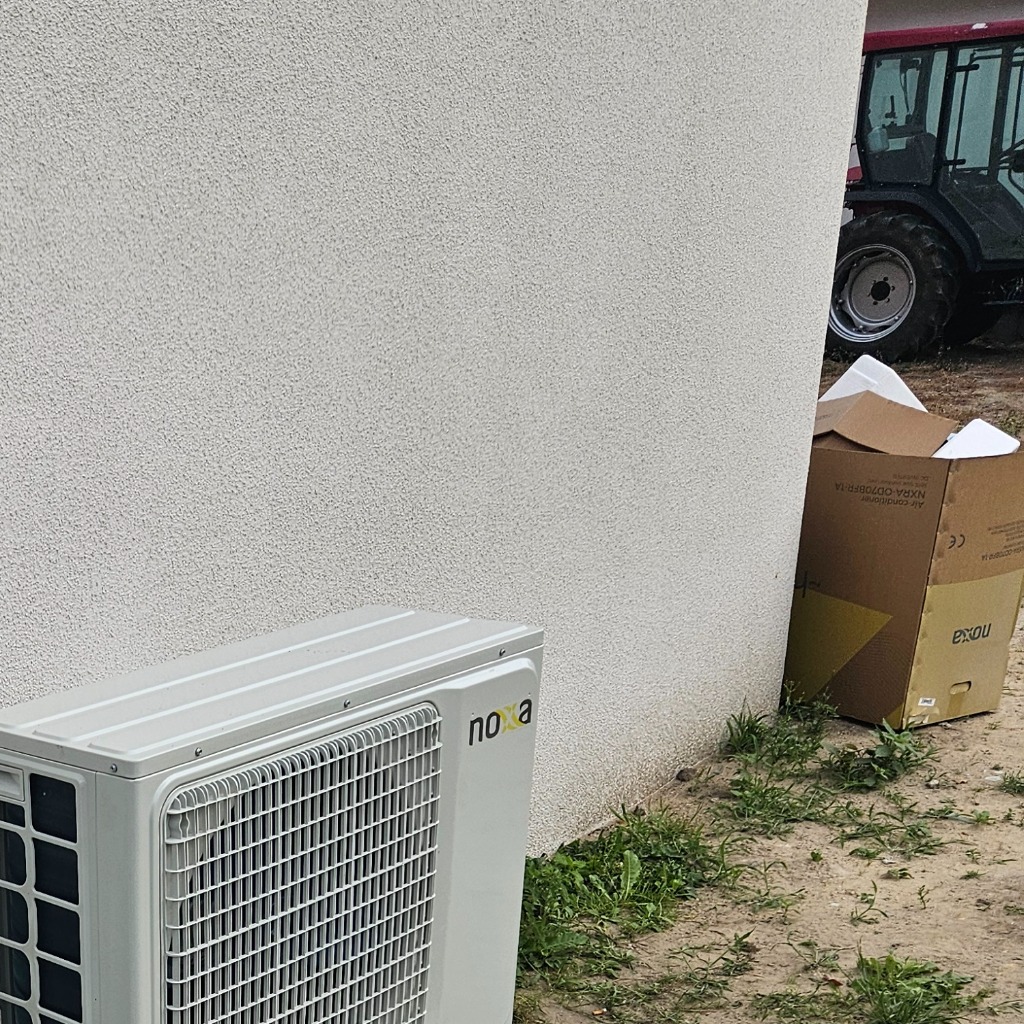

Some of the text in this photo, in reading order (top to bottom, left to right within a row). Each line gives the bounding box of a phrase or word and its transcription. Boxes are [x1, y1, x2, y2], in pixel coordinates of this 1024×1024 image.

[861, 495, 925, 509] Air conditioner
[947, 533, 966, 550] CE
[952, 623, 992, 645] noxa
[468, 698, 533, 747] noxa
